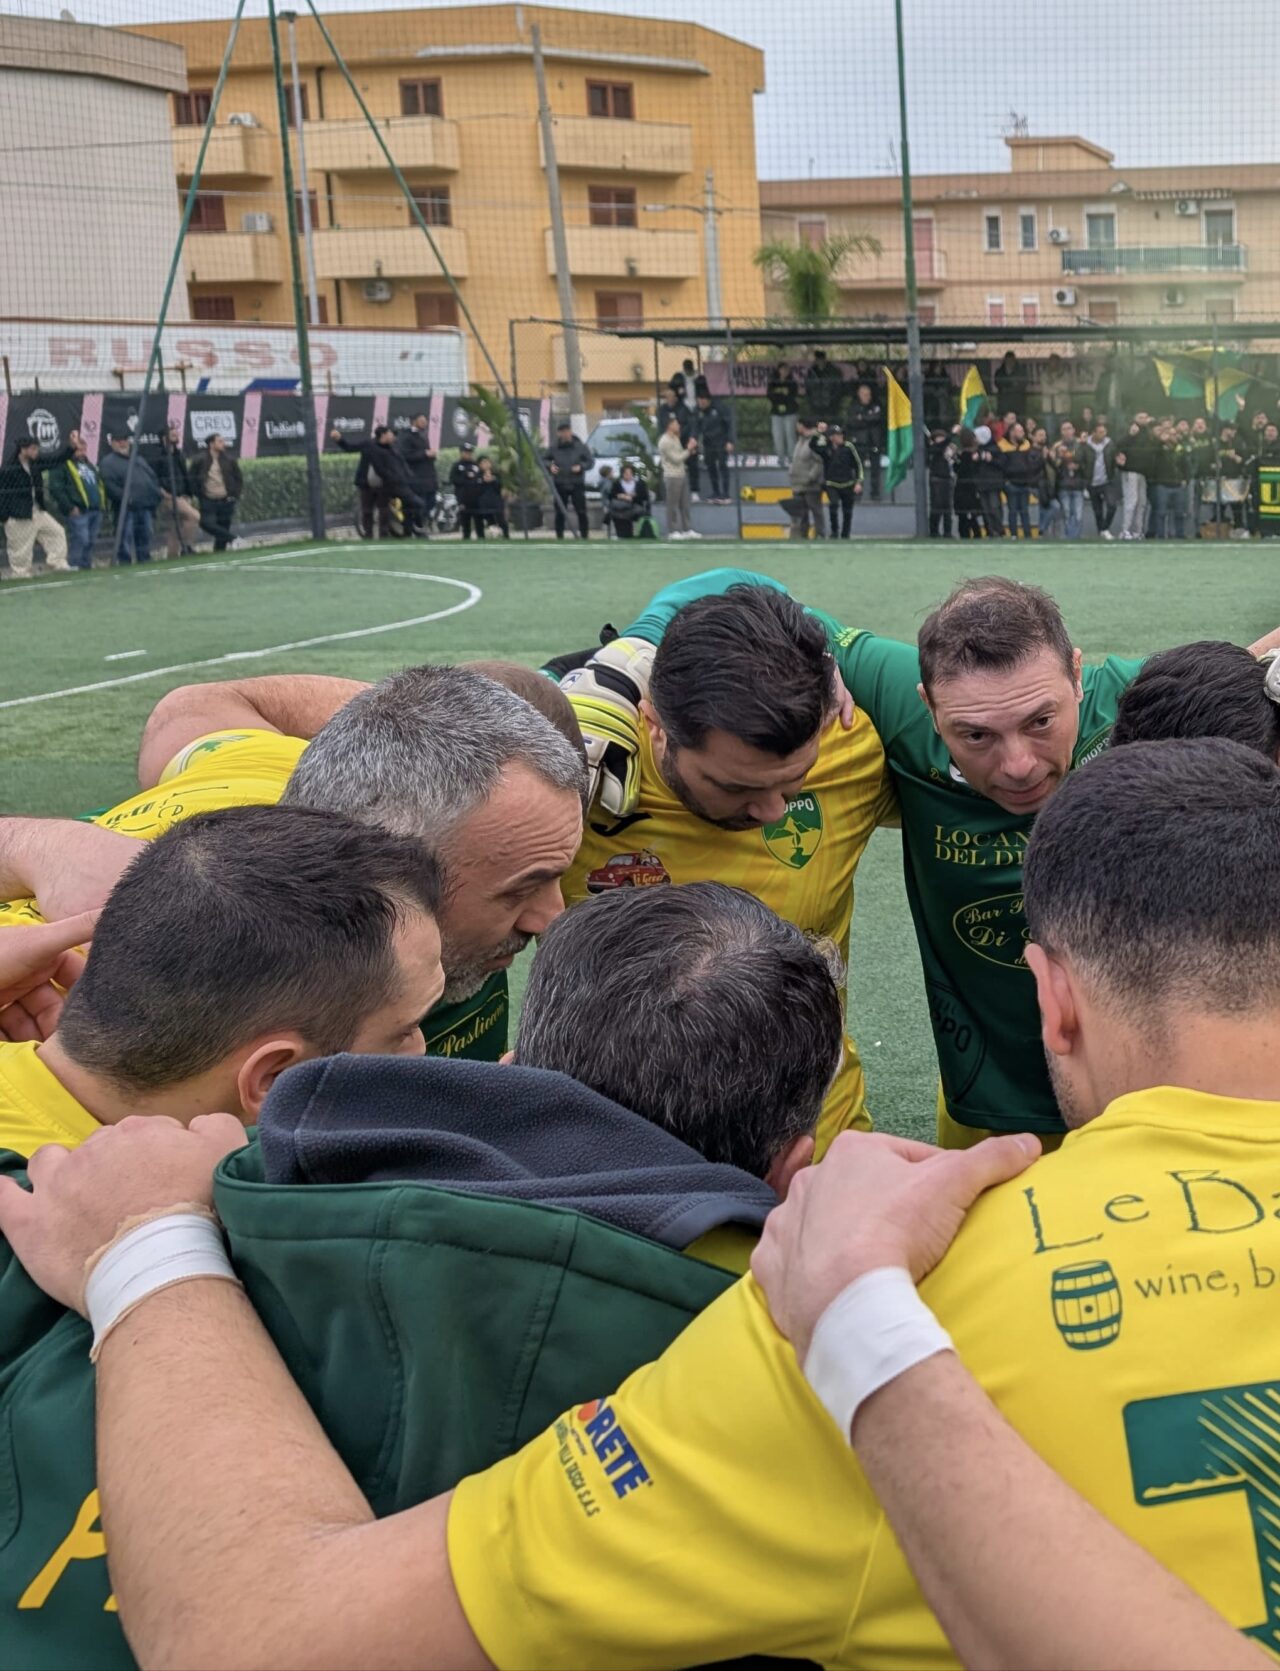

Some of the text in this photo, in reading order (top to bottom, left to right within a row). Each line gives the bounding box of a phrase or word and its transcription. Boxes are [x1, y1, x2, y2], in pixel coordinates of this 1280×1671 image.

[49, 337, 338, 368] RUSSO
[935, 844, 987, 866] DEL
[965, 907, 1003, 925] Bar
[969, 926, 1010, 947] Di
[1023, 1187, 1150, 1255] Le
[1134, 1264, 1240, 1298] wine,
